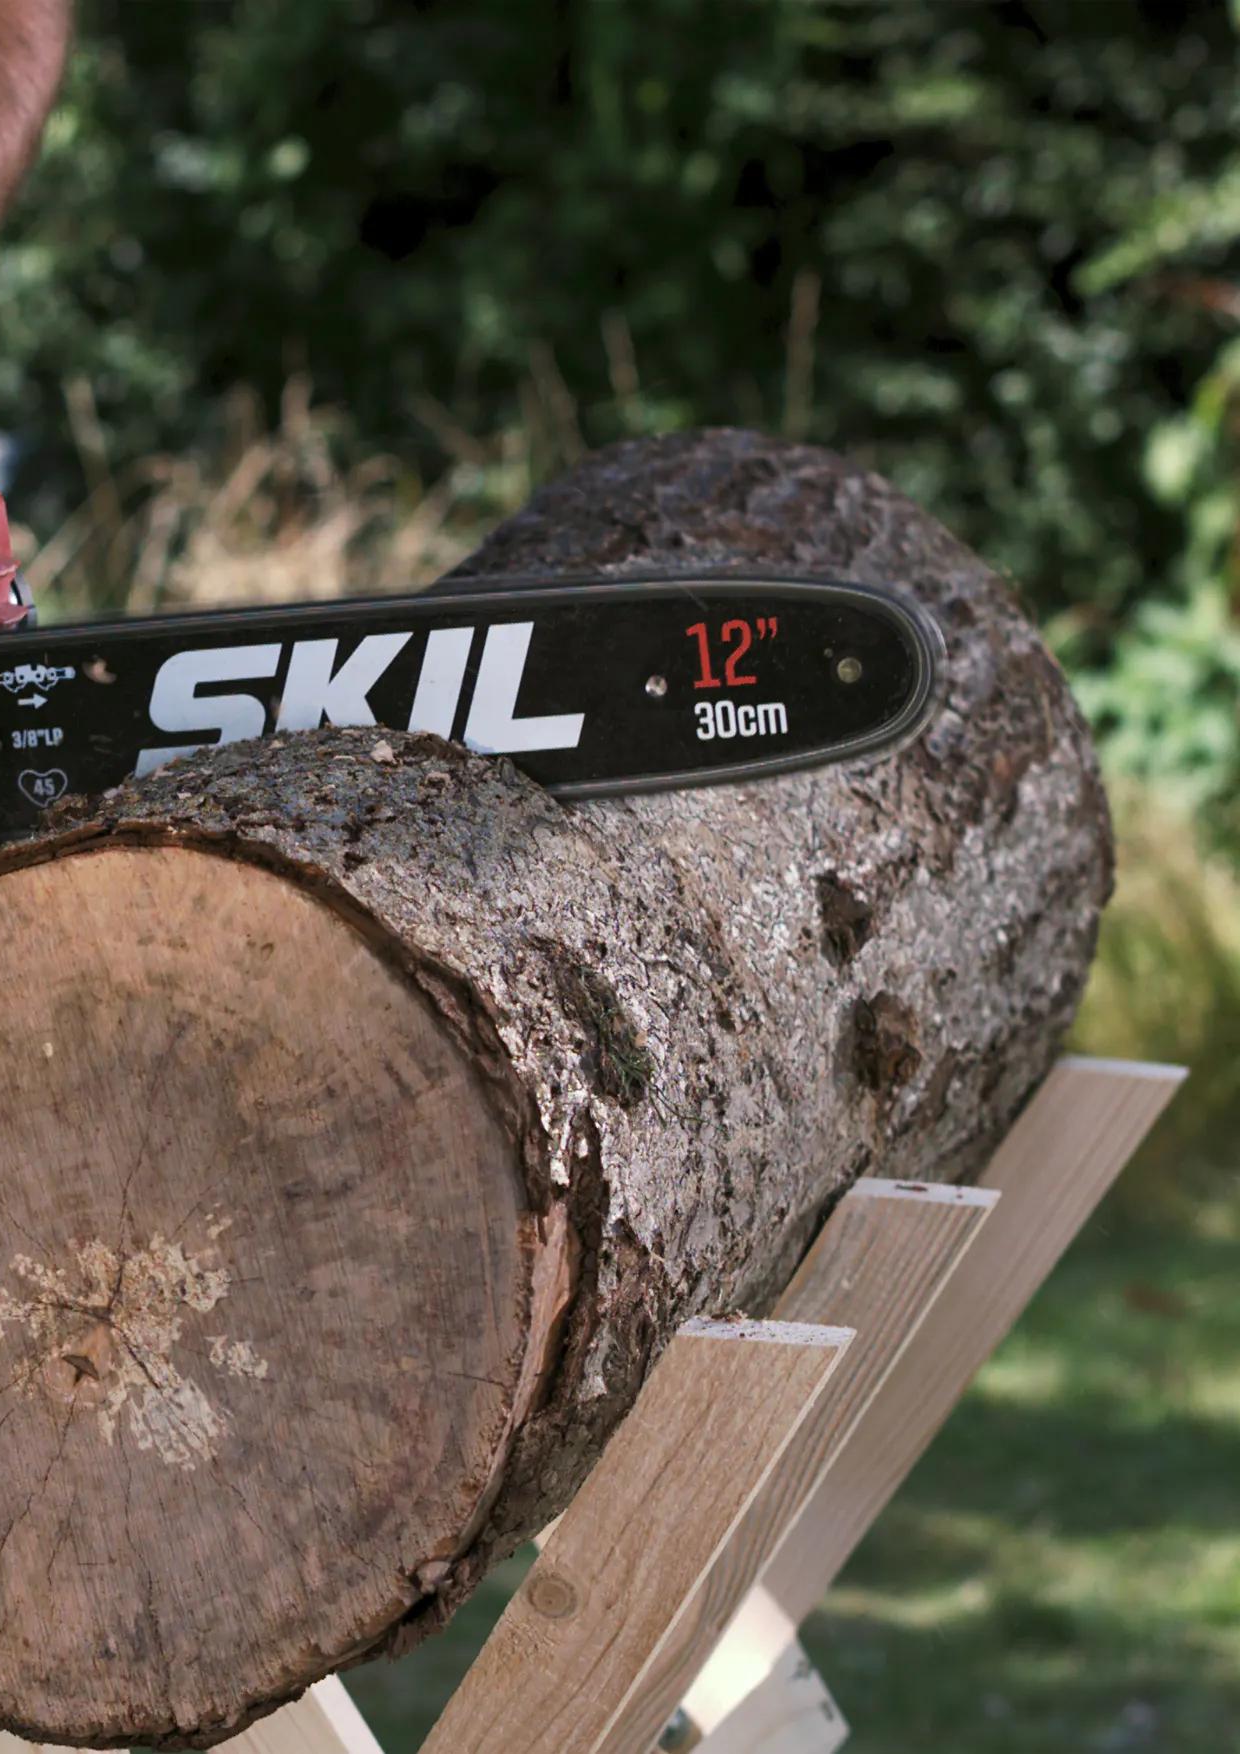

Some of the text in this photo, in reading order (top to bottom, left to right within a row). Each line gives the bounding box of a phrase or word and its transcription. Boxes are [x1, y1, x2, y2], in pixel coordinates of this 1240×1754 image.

[134, 621, 585, 778] SKIL
[693, 699, 789, 741] 30cm
[33, 778, 56, 797] 45
